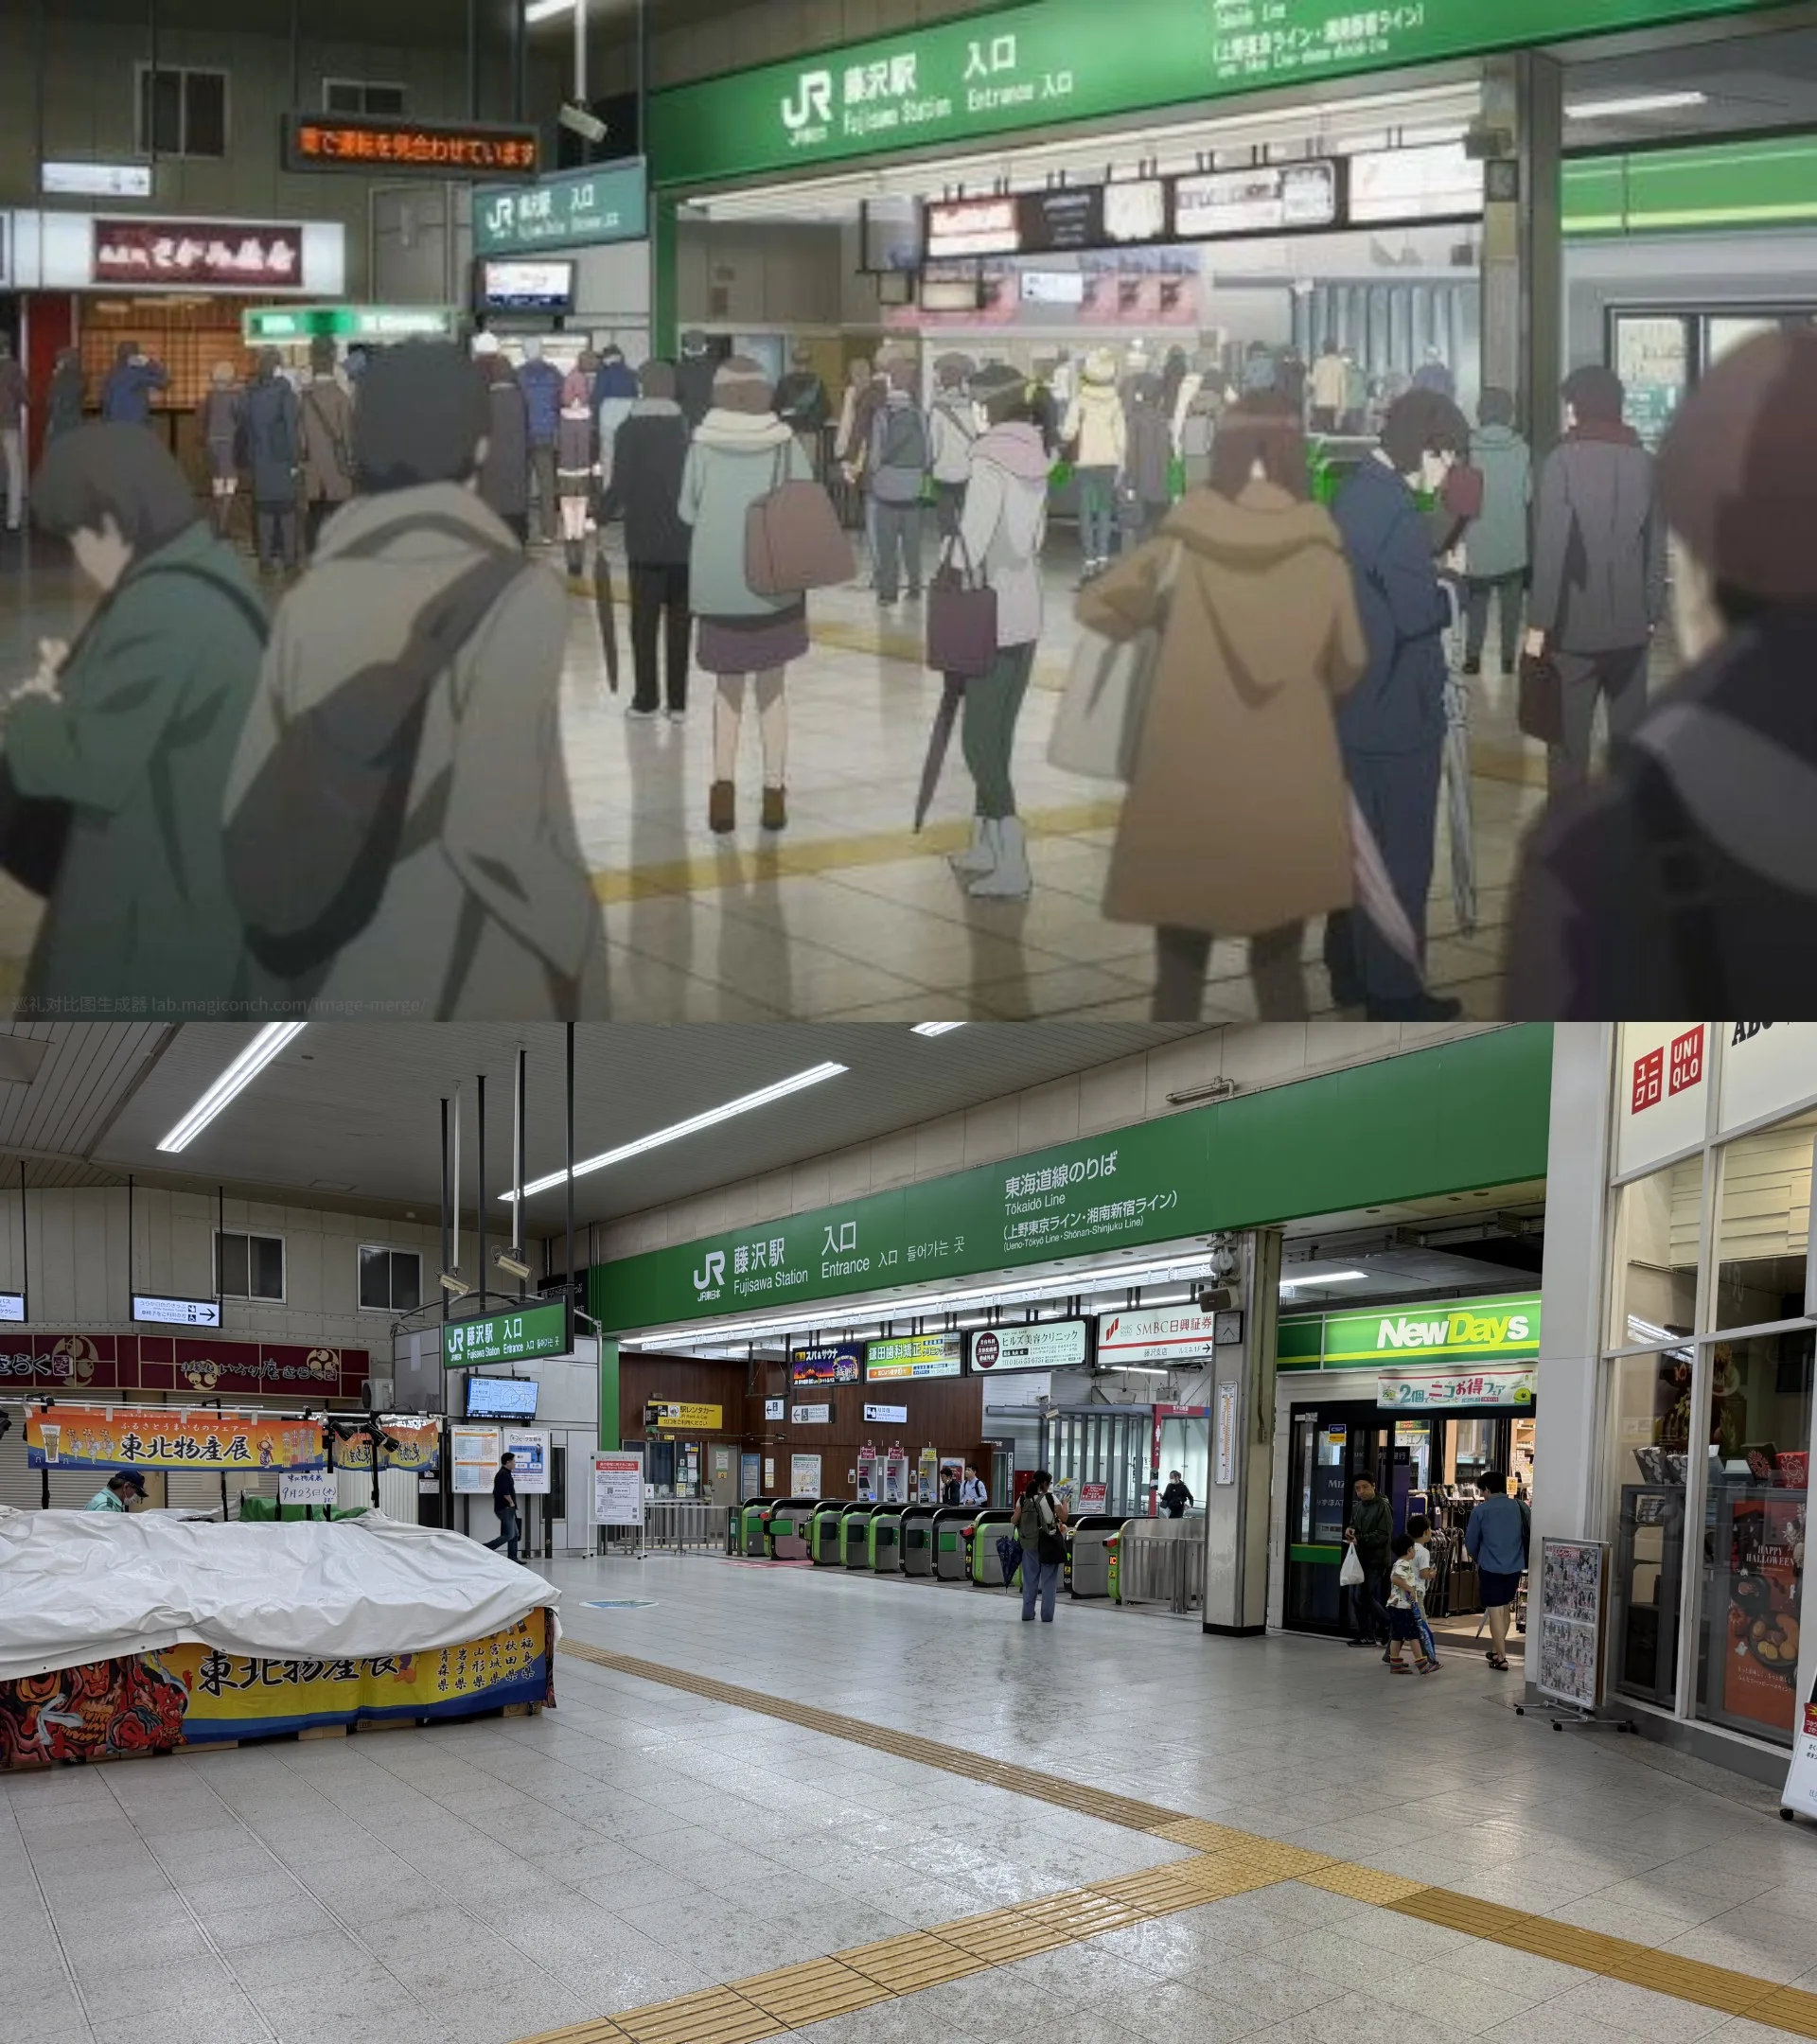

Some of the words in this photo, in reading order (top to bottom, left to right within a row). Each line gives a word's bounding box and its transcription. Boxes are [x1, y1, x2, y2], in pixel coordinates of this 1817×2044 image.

[963, 34, 1016, 79] 入口
[1042, 71, 1073, 97] 入口
[782, 70, 833, 129] JR
[485, 197, 513, 231] JR
[1673, 1034, 1699, 1064] UNI
[1636, 1056, 1659, 1084] ユニ
[1672, 1058, 1699, 1088] QLO
[1634, 1079, 1658, 1107] クロ
[1005, 1150, 1119, 1200] 東海道線のりば
[1005, 1197, 1042, 1216] Tōkaidō
[1045, 1193, 1066, 1208] Line
[821, 1223, 856, 1257] 入口
[694, 1250, 726, 1290] JR
[733, 1237, 785, 1275] 藤沢駅
[821, 1258, 870, 1278] Entrance
[878, 1249, 898, 1268] 入口
[907, 1241, 949, 1262] 들어가는
[954, 1236, 965, 1254] 곳
[697, 1288, 721, 1302] JR東日本
[733, 1278, 773, 1297] Fujisawa
[775, 1269, 808, 1287] Station
[467, 1322, 493, 1347] 藤沢駅
[503, 1317, 522, 1340] 入口
[1002, 1330, 1078, 1347] ヒルズ美容クリニック
[1137, 1316, 1212, 1336] SMBC日興証券
[1377, 1313, 1529, 1349] NewDays
[449, 1328, 464, 1353] JR
[467, 1348, 485, 1361] Fujisawa
[485, 1345, 501, 1357] Station
[503, 1343, 523, 1354] Entrance
[1144, 1348, 1168, 1357] 藤沢支店
[679, 1405, 714, 1414] 駅レンタカー
[120, 1422, 249, 1432] ふるさとうまいものフェアー
[119, 1433, 252, 1463] 東北物産展
[1109, 1556, 1118, 1565] IC
[1746, 1553, 1794, 1566] HALLOWEEN
[1757, 1544, 1782, 1556] HAPPY
[437, 1648, 451, 1692] 青森県
[455, 1648, 467, 1690] 岩手県
[472, 1648, 485, 1687] 山形県
[490, 1643, 503, 1684] 宮城県
[505, 1640, 518, 1682] 秋田県
[520, 1637, 535, 1680] 福島県
